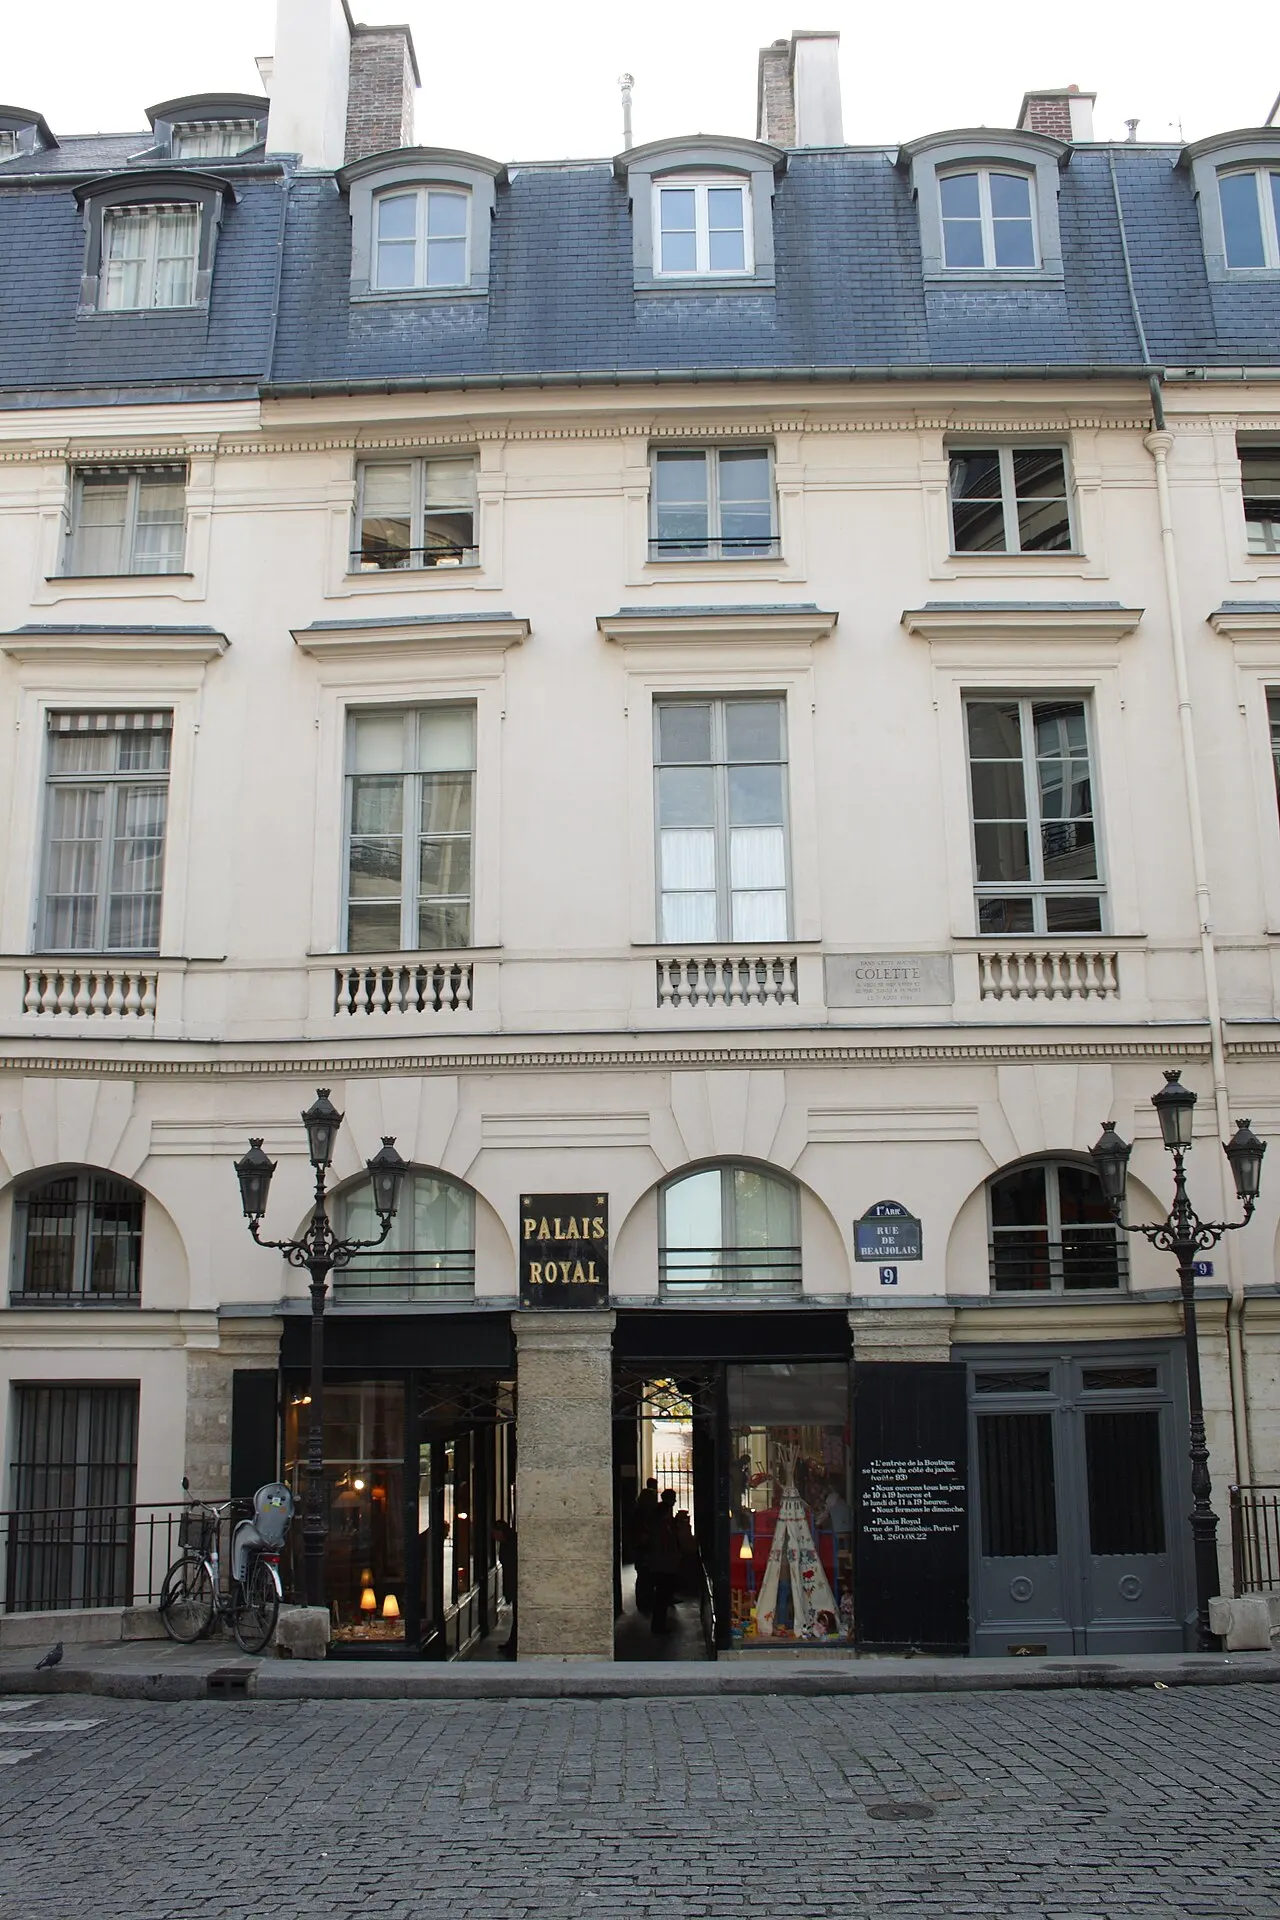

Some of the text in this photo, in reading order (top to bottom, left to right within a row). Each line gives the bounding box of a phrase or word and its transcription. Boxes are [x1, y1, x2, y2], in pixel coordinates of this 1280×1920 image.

[855, 968, 920, 980] COLETTE
[523, 1216, 605, 1240] PALAIS
[877, 1226, 899, 1235] RUE
[881, 1236, 895, 1245] DE
[861, 1246, 917, 1256] BEAUJOLAIS
[529, 1261, 600, 1284] ROYAL
[1199, 1263, 1207, 1275] 9
[883, 1268, 894, 1284] 9
[924, 1460, 955, 1468] Boutique
[948, 1484, 965, 1492] jours
[900, 1518, 921, 1526] Royal
